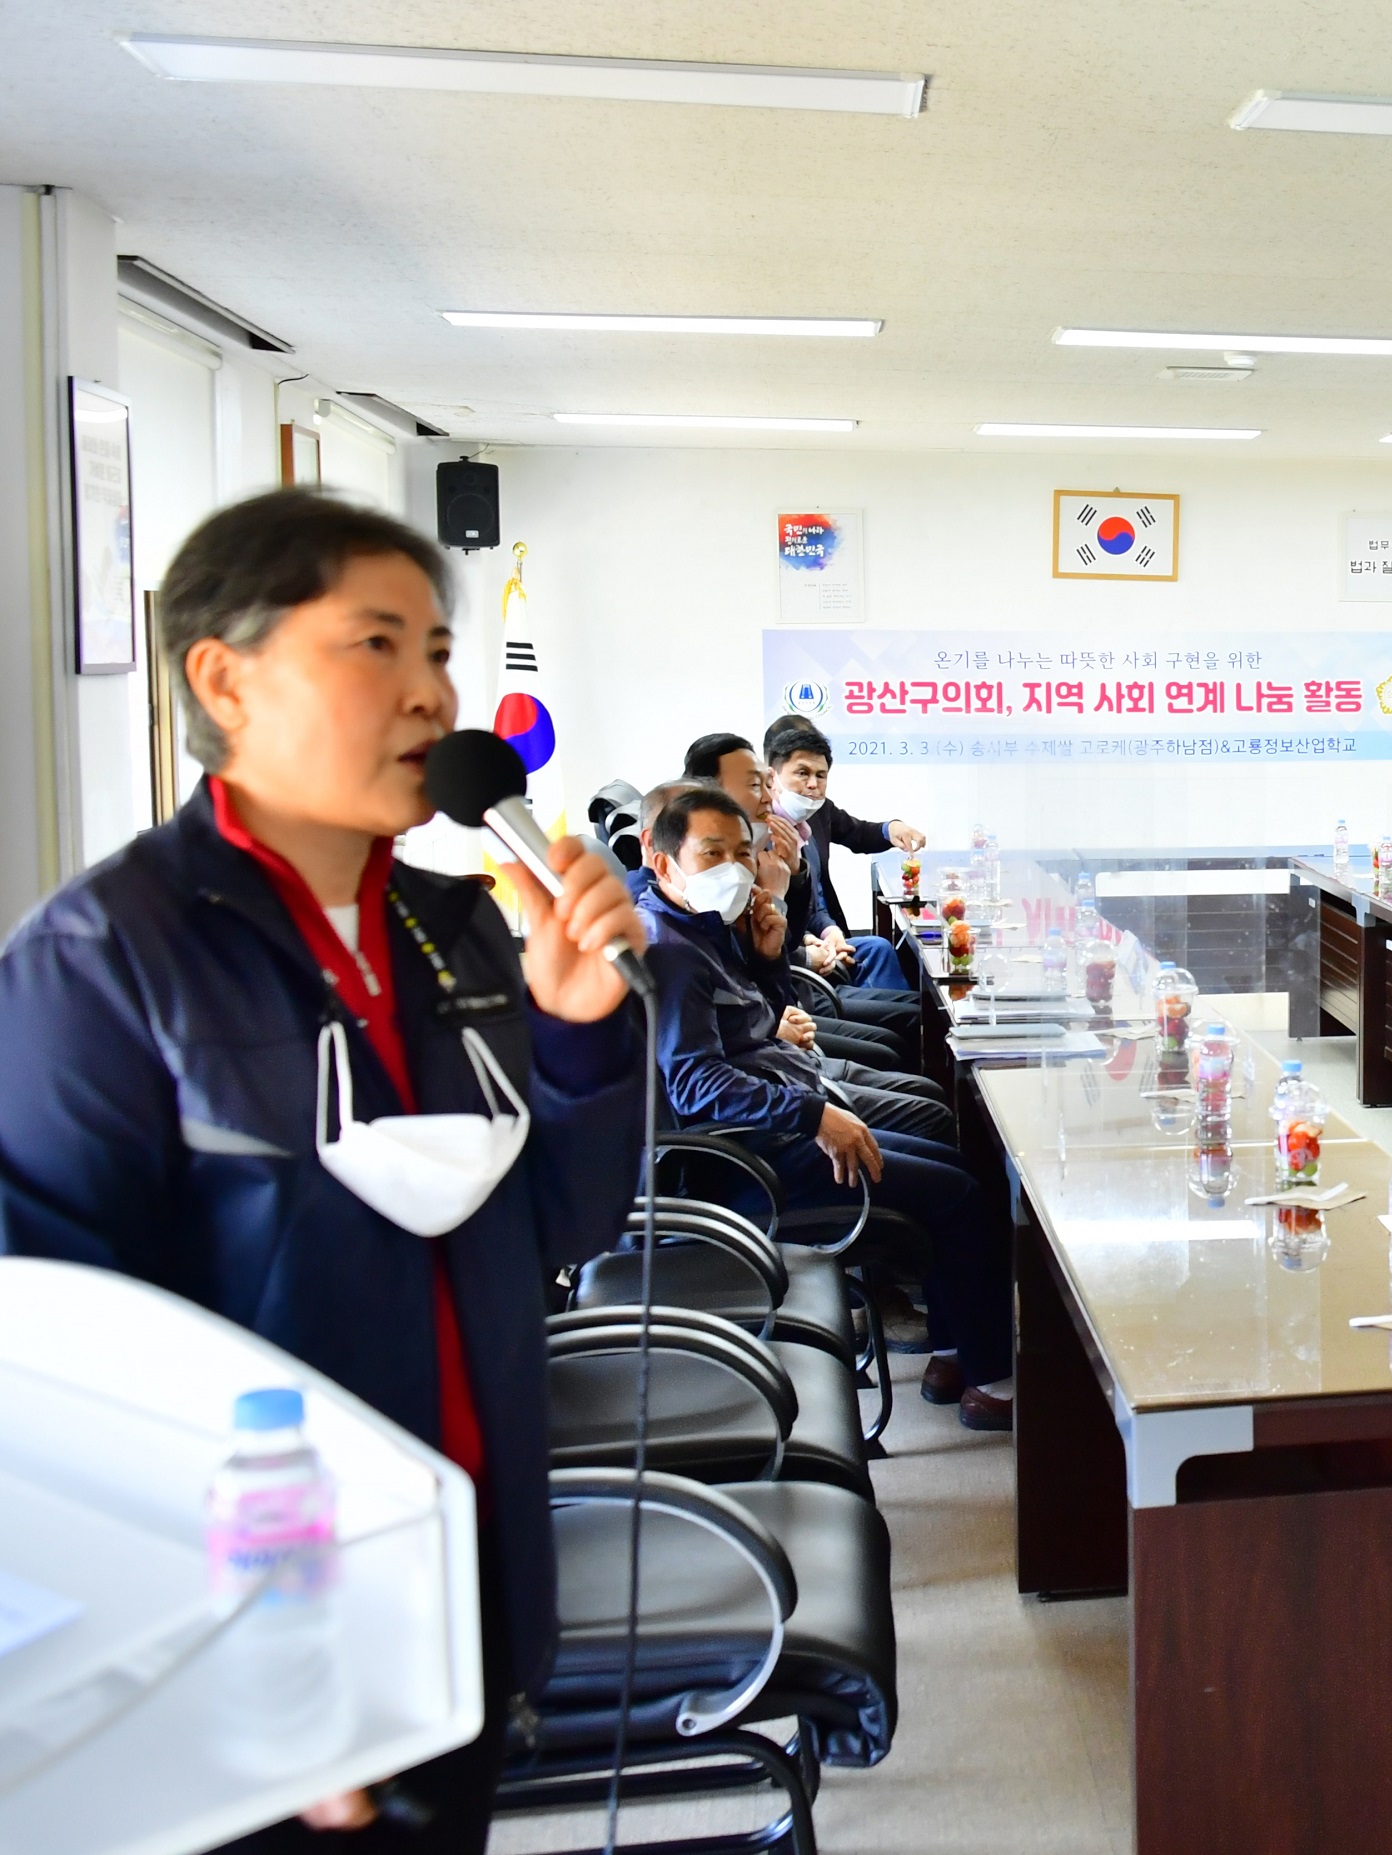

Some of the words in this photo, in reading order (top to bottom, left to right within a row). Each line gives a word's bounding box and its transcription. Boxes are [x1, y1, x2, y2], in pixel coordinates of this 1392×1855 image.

[808, 525, 825, 535] 나라
[784, 544, 825, 557] 대한민국
[1350, 560, 1377, 574] 법과
[933, 650, 990, 670] 온기를
[997, 650, 1053, 670] 나누는
[1060, 650, 1115, 670] 따뜻한
[1122, 650, 1158, 670] 사회
[1165, 650, 1220, 670] 구현을
[1227, 650, 1263, 670] 위한
[844, 680, 1012, 717] 광산구의회,
[1022, 681, 1084, 714] 지역
[1093, 681, 1154, 714] 사회
[1165, 681, 1225, 714] 연계
[1235, 681, 1294, 714] 나눔
[1303, 680, 1362, 713] 활동
[848, 741, 893, 756] 2021.
[900, 741, 913, 756] 3.
[920, 741, 930, 756] 3
[936, 741, 964, 757] (수)
